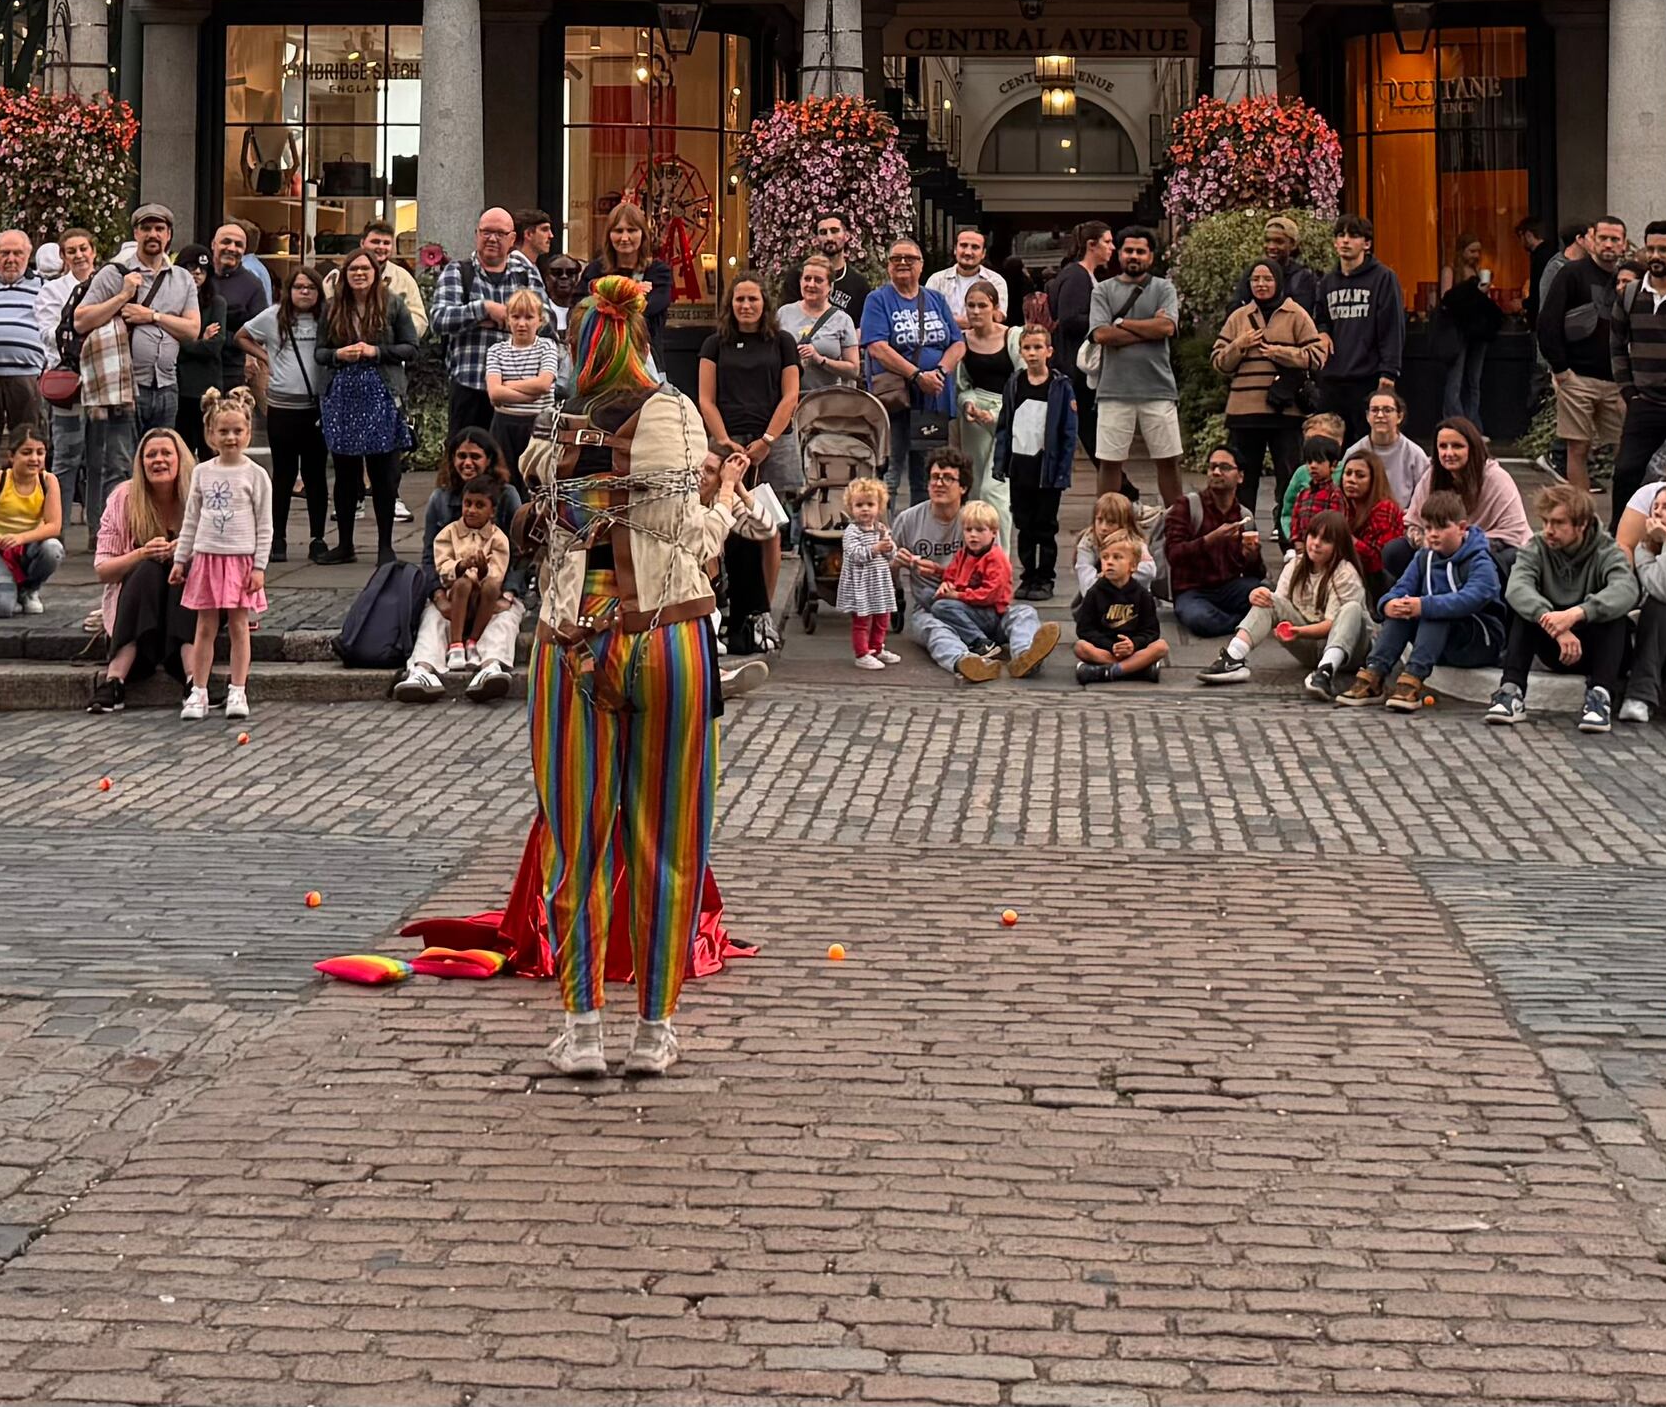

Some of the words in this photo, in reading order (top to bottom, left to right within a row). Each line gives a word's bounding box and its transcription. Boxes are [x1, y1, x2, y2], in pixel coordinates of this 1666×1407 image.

[905, 28, 1052, 52] CENTRAL
[1060, 28, 1189, 52] AVENUE
[1106, 604, 1134, 620] NIKE
